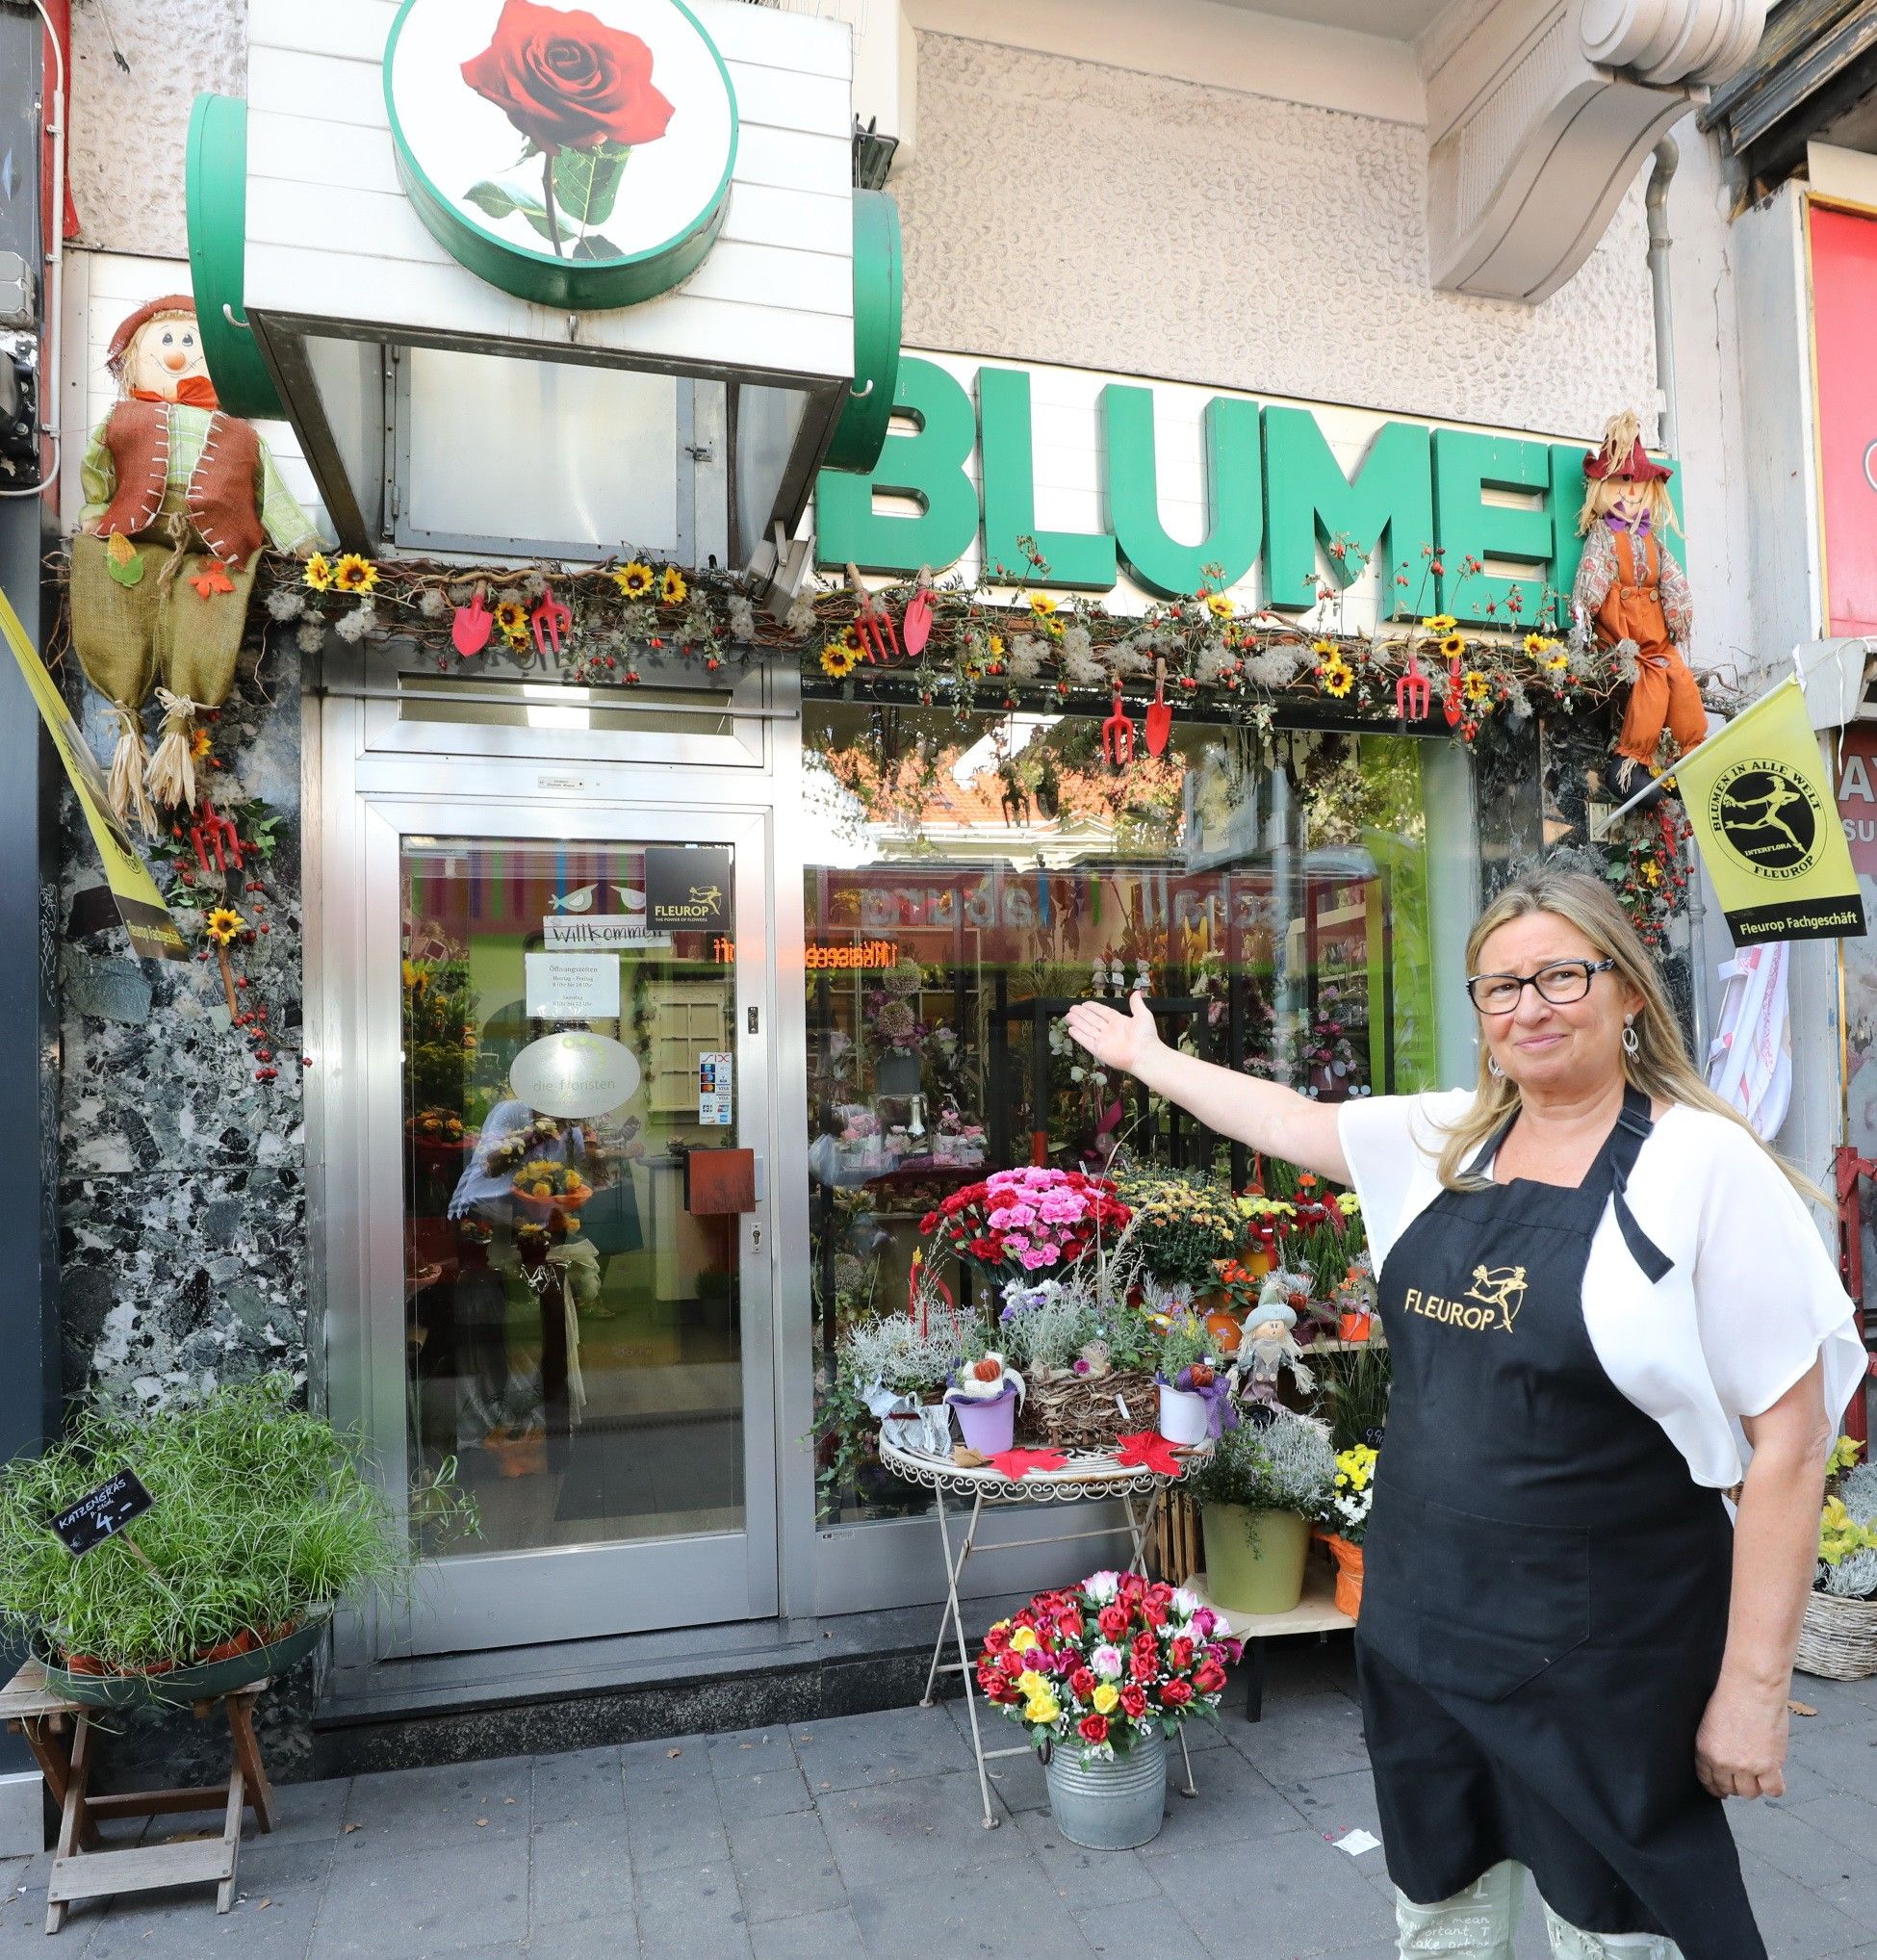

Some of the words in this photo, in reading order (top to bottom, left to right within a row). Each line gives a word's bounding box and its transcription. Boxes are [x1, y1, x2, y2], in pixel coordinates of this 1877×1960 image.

[1838, 755, 1877, 802] A
[1710, 775, 1731, 832] BLUMEN
[1731, 764, 1746, 777] IN
[1752, 761, 1788, 775] ALLE
[1792, 772, 1821, 811] WELT
[1744, 842, 1792, 857] INTERFLORA
[1754, 855, 1813, 879] FLEUROP
[655, 905, 709, 916] FLEUROP
[1739, 920, 1785, 935] Fleurop
[1786, 911, 1858, 929] Fachgeschäft
[549, 965, 598, 973] Öffnungszeiten
[702, 1054, 730, 1063] SIX
[533, 1080, 553, 1092] die
[1404, 1288, 1495, 1330] FLEUROP
